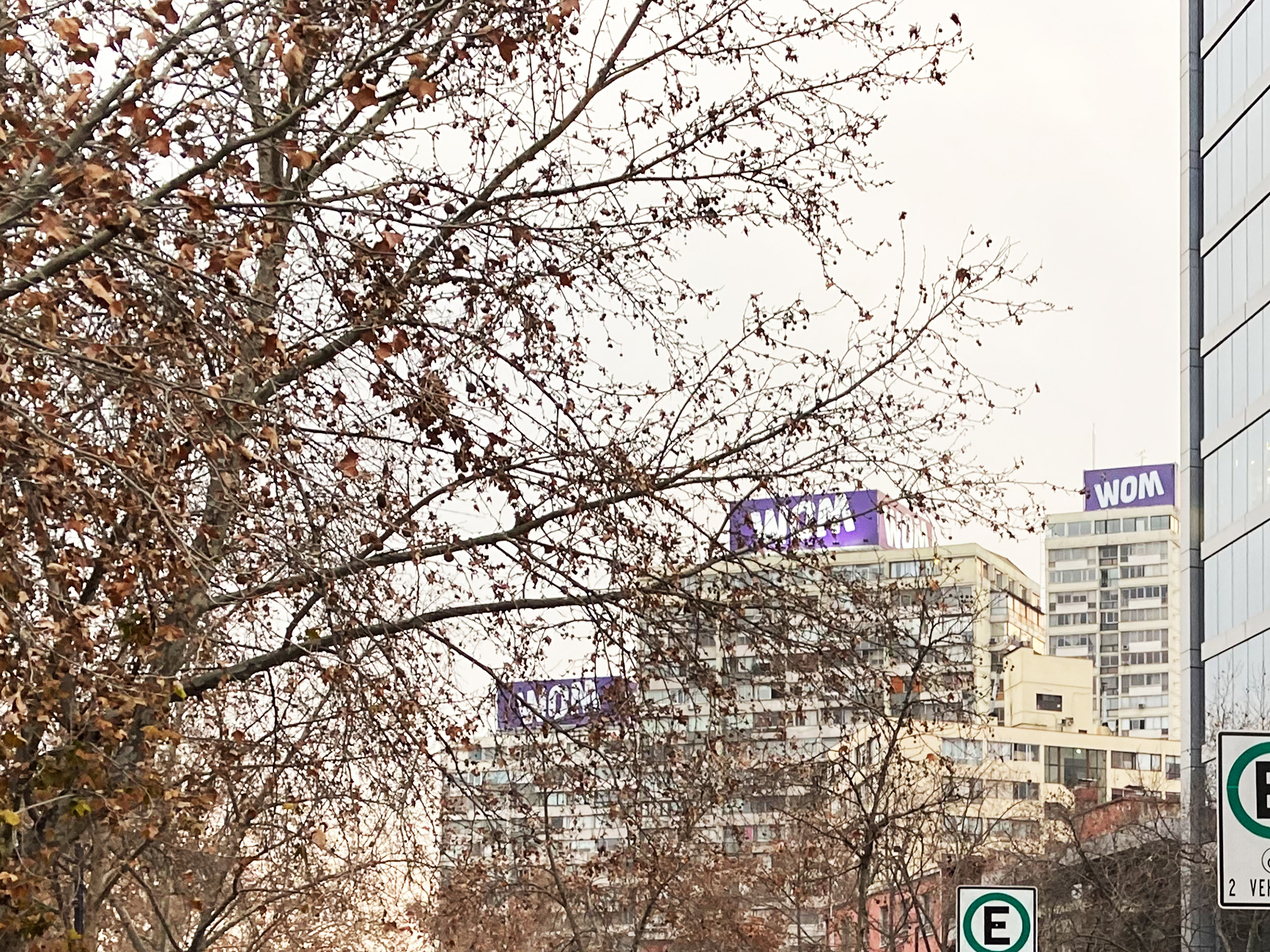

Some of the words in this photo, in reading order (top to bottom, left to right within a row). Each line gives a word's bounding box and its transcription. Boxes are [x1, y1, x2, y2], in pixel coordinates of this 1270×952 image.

[1094, 470, 1164, 509] WOM
[750, 493, 856, 544] WOM
[883, 504, 930, 549] WOM
[516, 679, 602, 725] WOM
[1228, 878, 1236, 897] 2
[983, 906, 1011, 946] E
